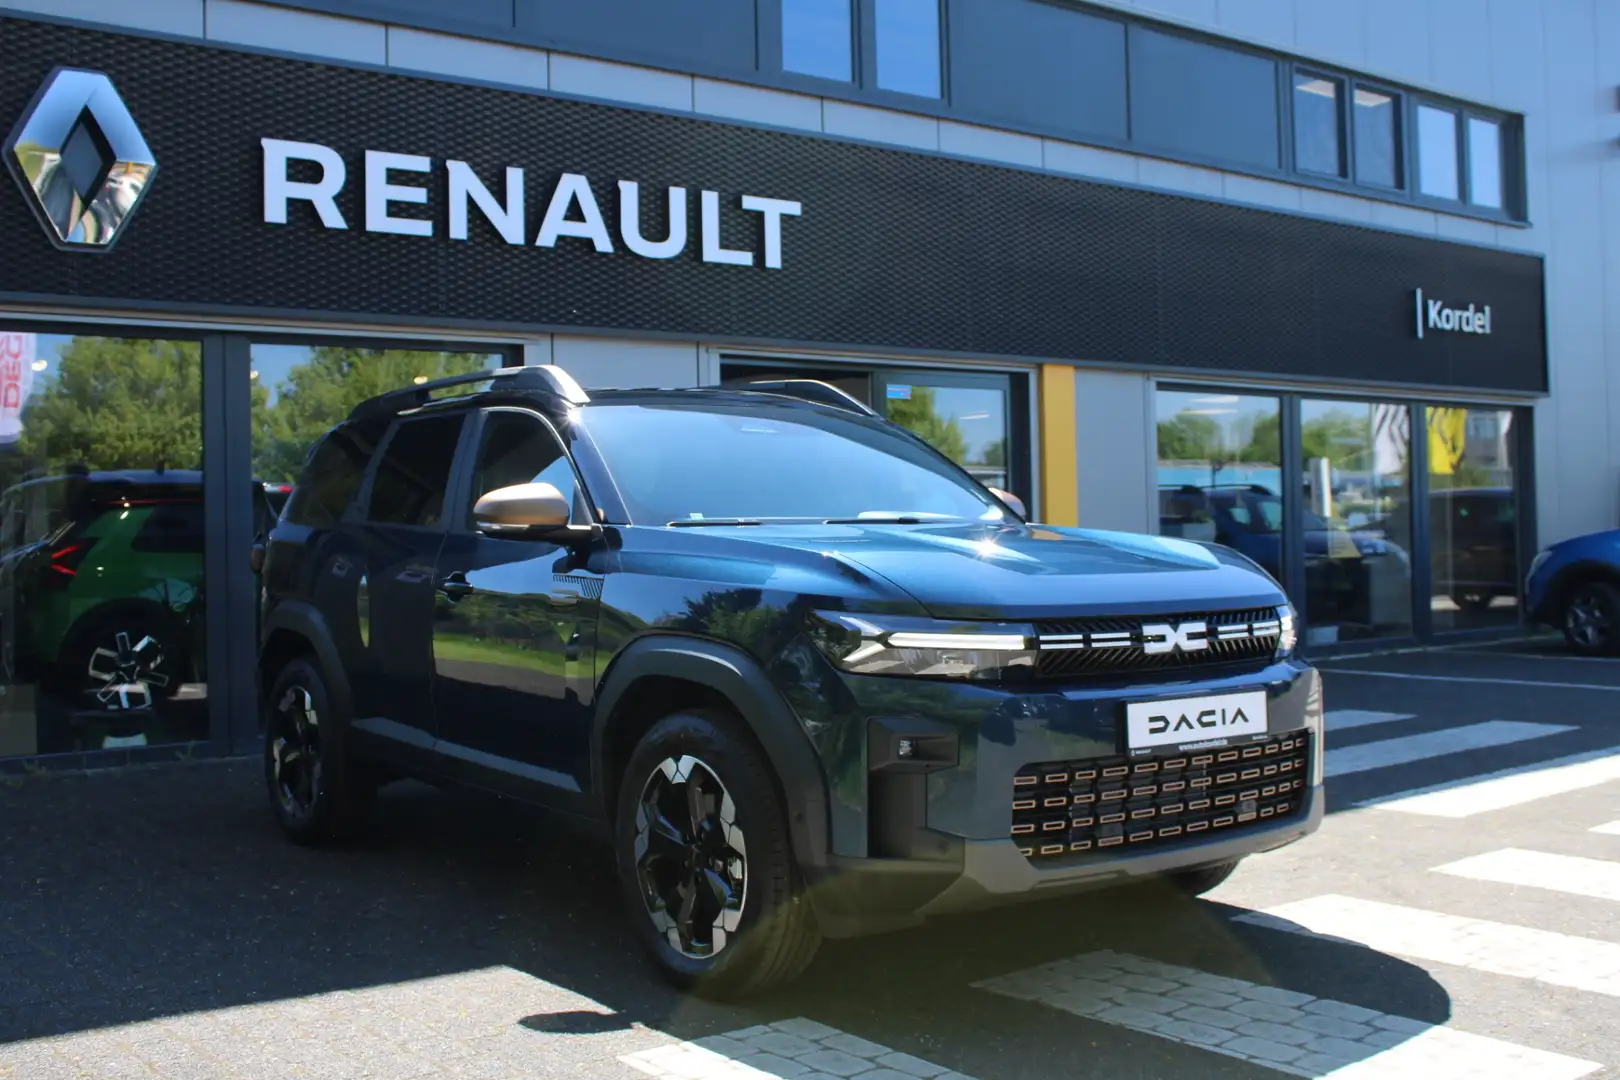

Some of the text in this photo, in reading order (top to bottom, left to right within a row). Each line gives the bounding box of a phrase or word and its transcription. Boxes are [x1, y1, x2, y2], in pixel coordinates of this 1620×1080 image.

[261, 137, 802, 269] RENAULT
[1427, 299, 1491, 334] Kordel
[1148, 707, 1249, 734] DACIA
